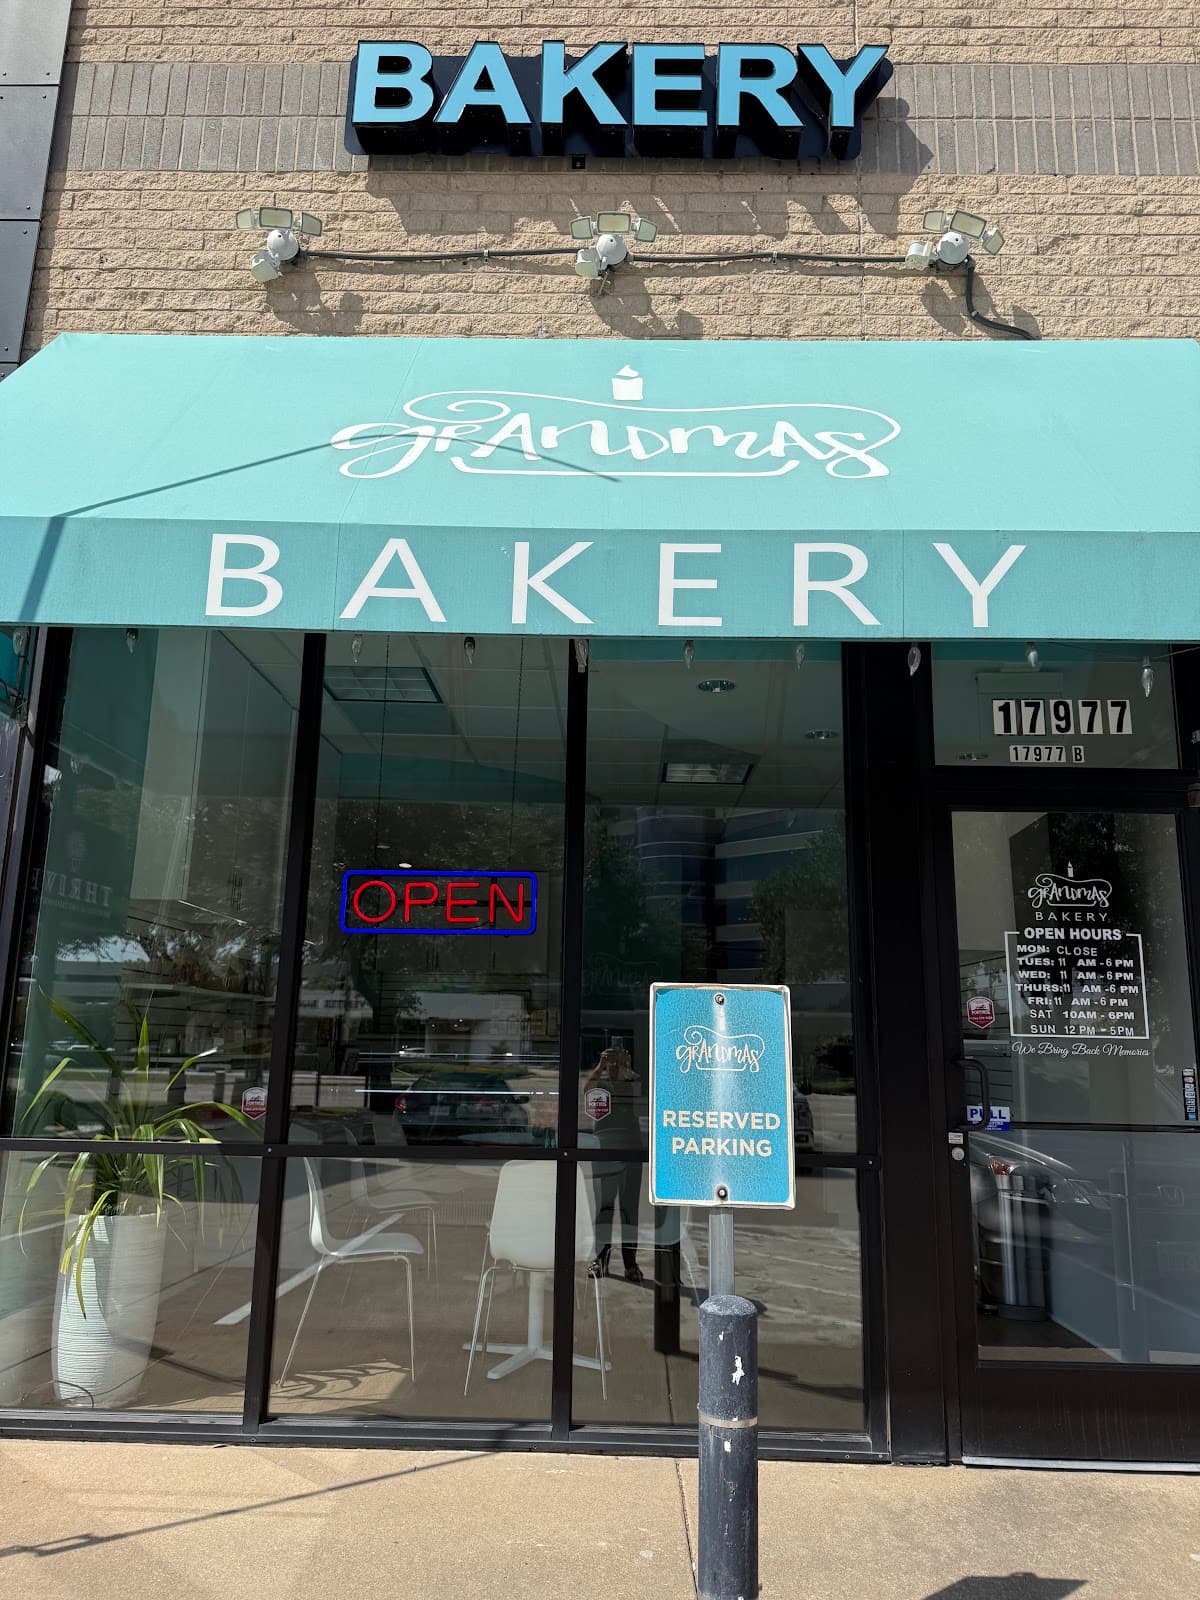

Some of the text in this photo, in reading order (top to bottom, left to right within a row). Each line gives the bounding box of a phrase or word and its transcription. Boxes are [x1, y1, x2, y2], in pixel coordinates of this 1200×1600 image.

[352, 41, 890, 129] BAKERY
[204, 533, 1026, 629] BAKERY
[998, 701, 1127, 734] 17977
[1012, 746, 1083, 761] 17977 B
[353, 880, 524, 923] OPEN
[1035, 911, 1108, 922] BAKERY
[1024, 928, 1122, 941] OPEN HOURS
[1016, 945, 1098, 956] MON: CLOSE
[1016, 957, 1055, 966] TUES:
[1058, 957, 1066, 967] 11
[1076, 958, 1097, 967] AM
[1115, 959, 1134, 968] PM
[1018, 970, 1051, 979] WED:
[1060, 970, 1068, 980] 11
[1076, 971, 1097, 980] AM
[1115, 972, 1134, 981] PM
[1082, 984, 1101, 993] AM
[1120, 985, 1139, 994] PM
[1028, 996, 1052, 1006] FRI:
[1054, 996, 1062, 1006] 11
[1071, 998, 1091, 1006] AM
[1110, 998, 1129, 1007] PM
[1030, 1009, 1053, 1019] SAT
[1062, 1010, 1097, 1019] 10AM
[1108, 1011, 1135, 1020] 6PM
[1030, 1024, 1056, 1034] SUN
[1064, 1025, 1076, 1035] 12
[1079, 1025, 1096, 1036] PM
[1011, 1041, 1151, 1058] We Bring Back Memories
[662, 1110, 781, 1130] RESERVED
[671, 1137, 772, 1157] PARKING
